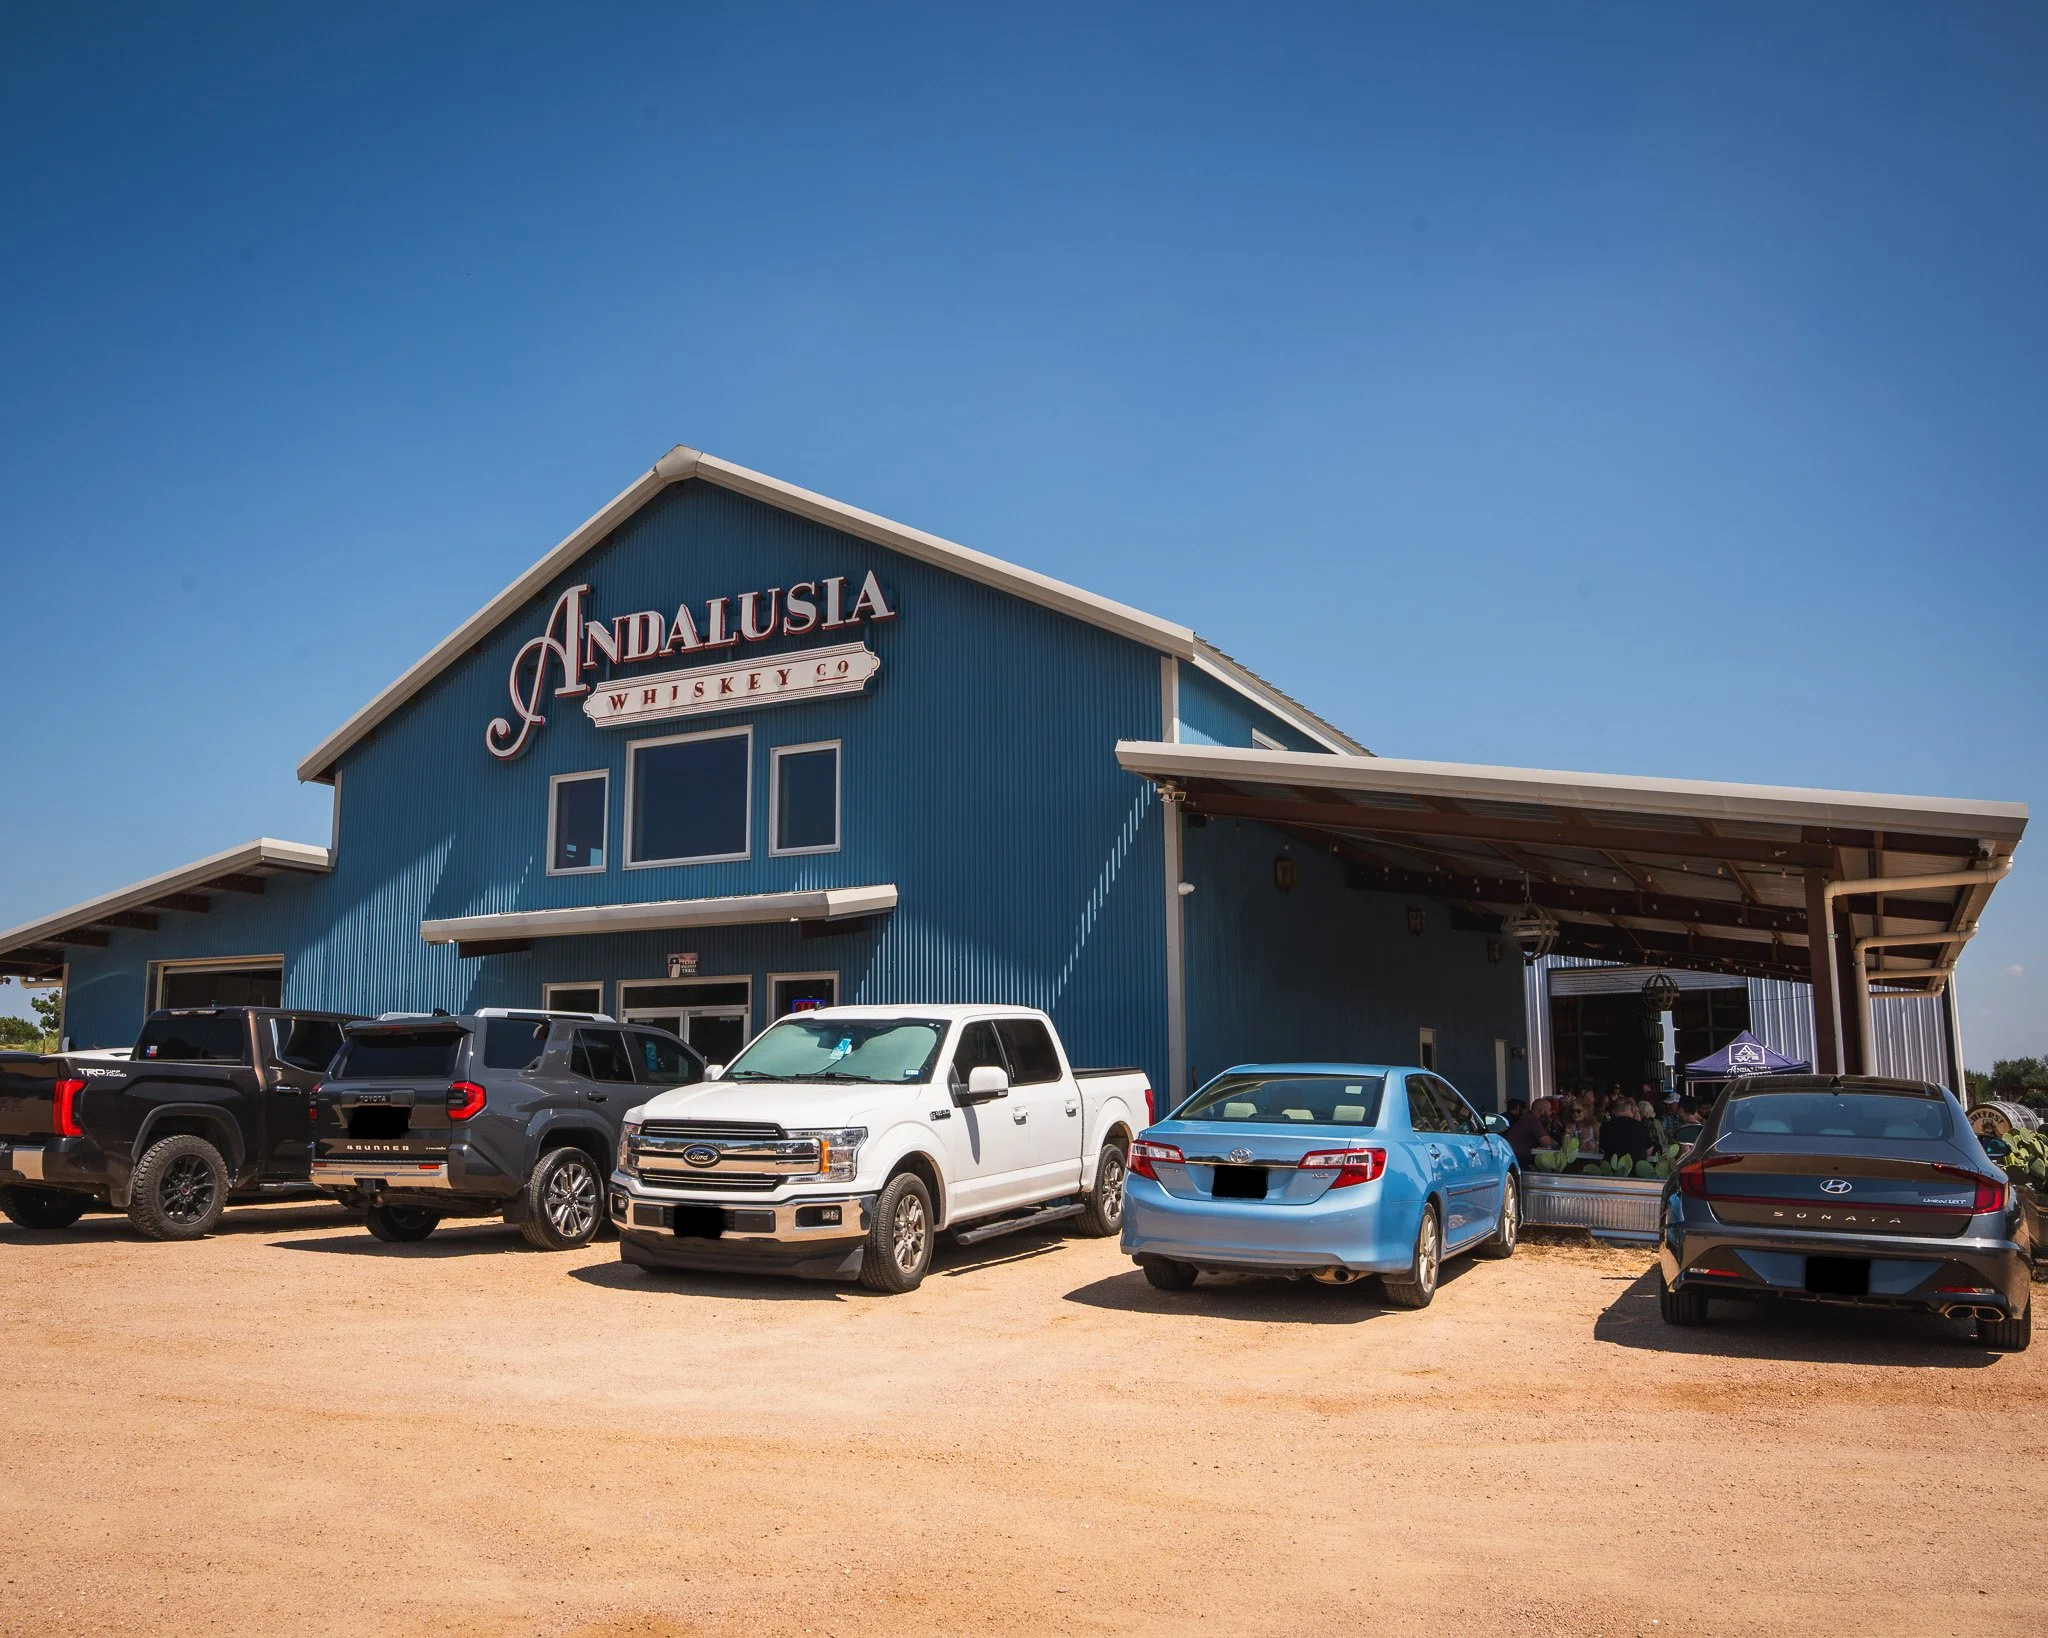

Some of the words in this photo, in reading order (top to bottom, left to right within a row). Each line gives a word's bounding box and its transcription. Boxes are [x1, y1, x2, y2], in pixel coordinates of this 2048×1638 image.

[485, 569, 896, 761] ANDALUSIA
[608, 668, 792, 711] WHISKEY
[77, 1067, 105, 1077] TRD
[690, 1150, 708, 1161] Ford
[1773, 1211, 1901, 1224] SONATA
